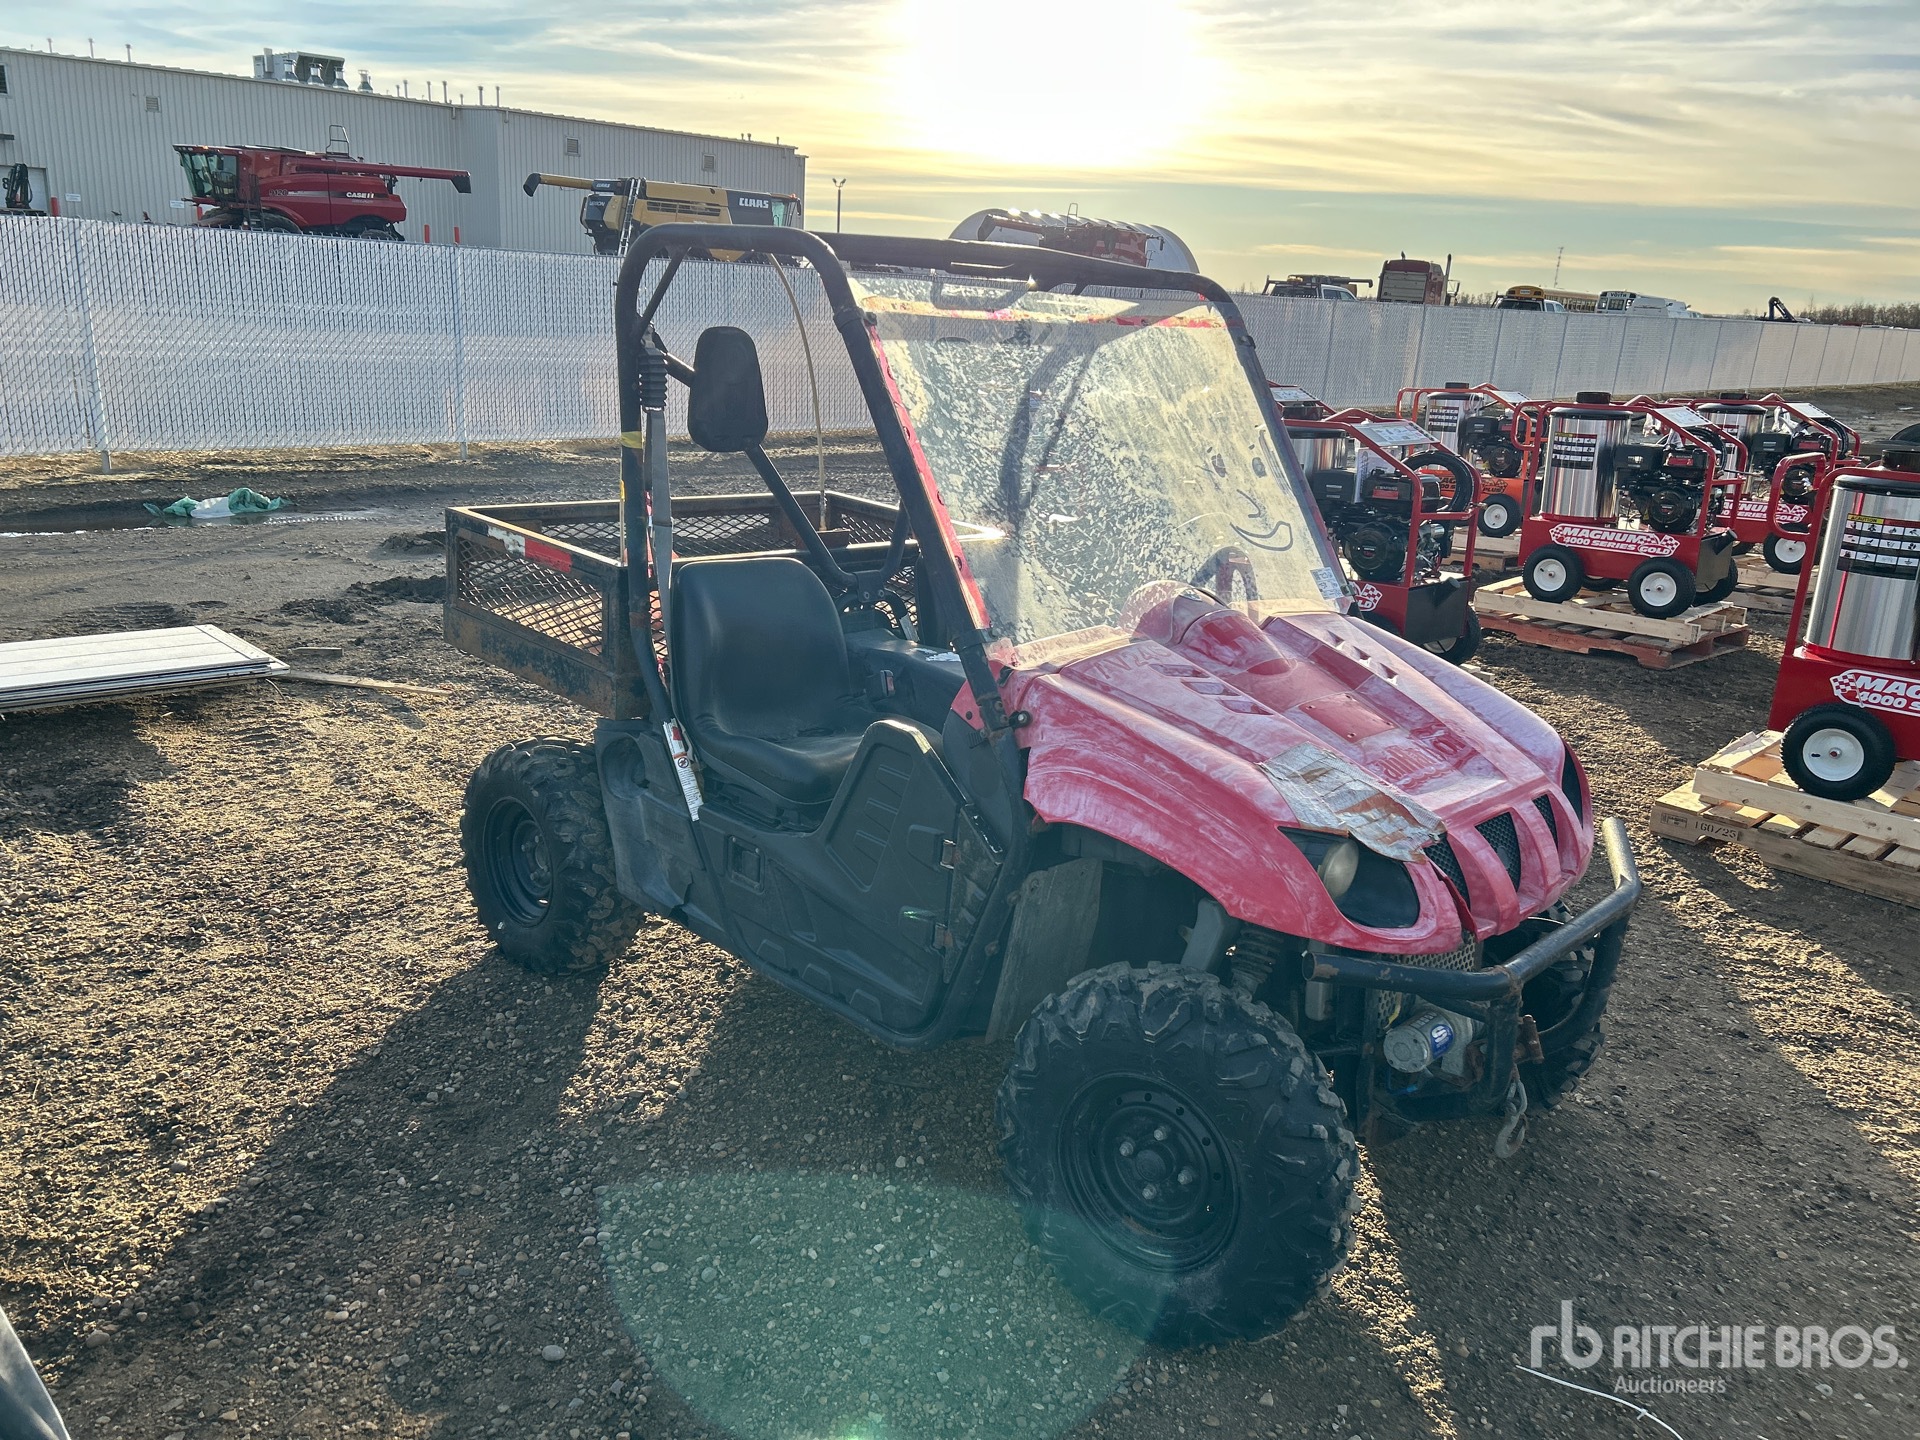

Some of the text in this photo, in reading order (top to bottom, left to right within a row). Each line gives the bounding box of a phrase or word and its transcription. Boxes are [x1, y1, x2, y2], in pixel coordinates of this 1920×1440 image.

[738, 197, 769, 209] CLAAS
[1562, 527, 1644, 544] MAGNUM
[1563, 536, 1671, 555] 4000 SERIES GOLD
[1856, 691, 1907, 709] 4000
[1694, 820, 1737, 839] 160/25
